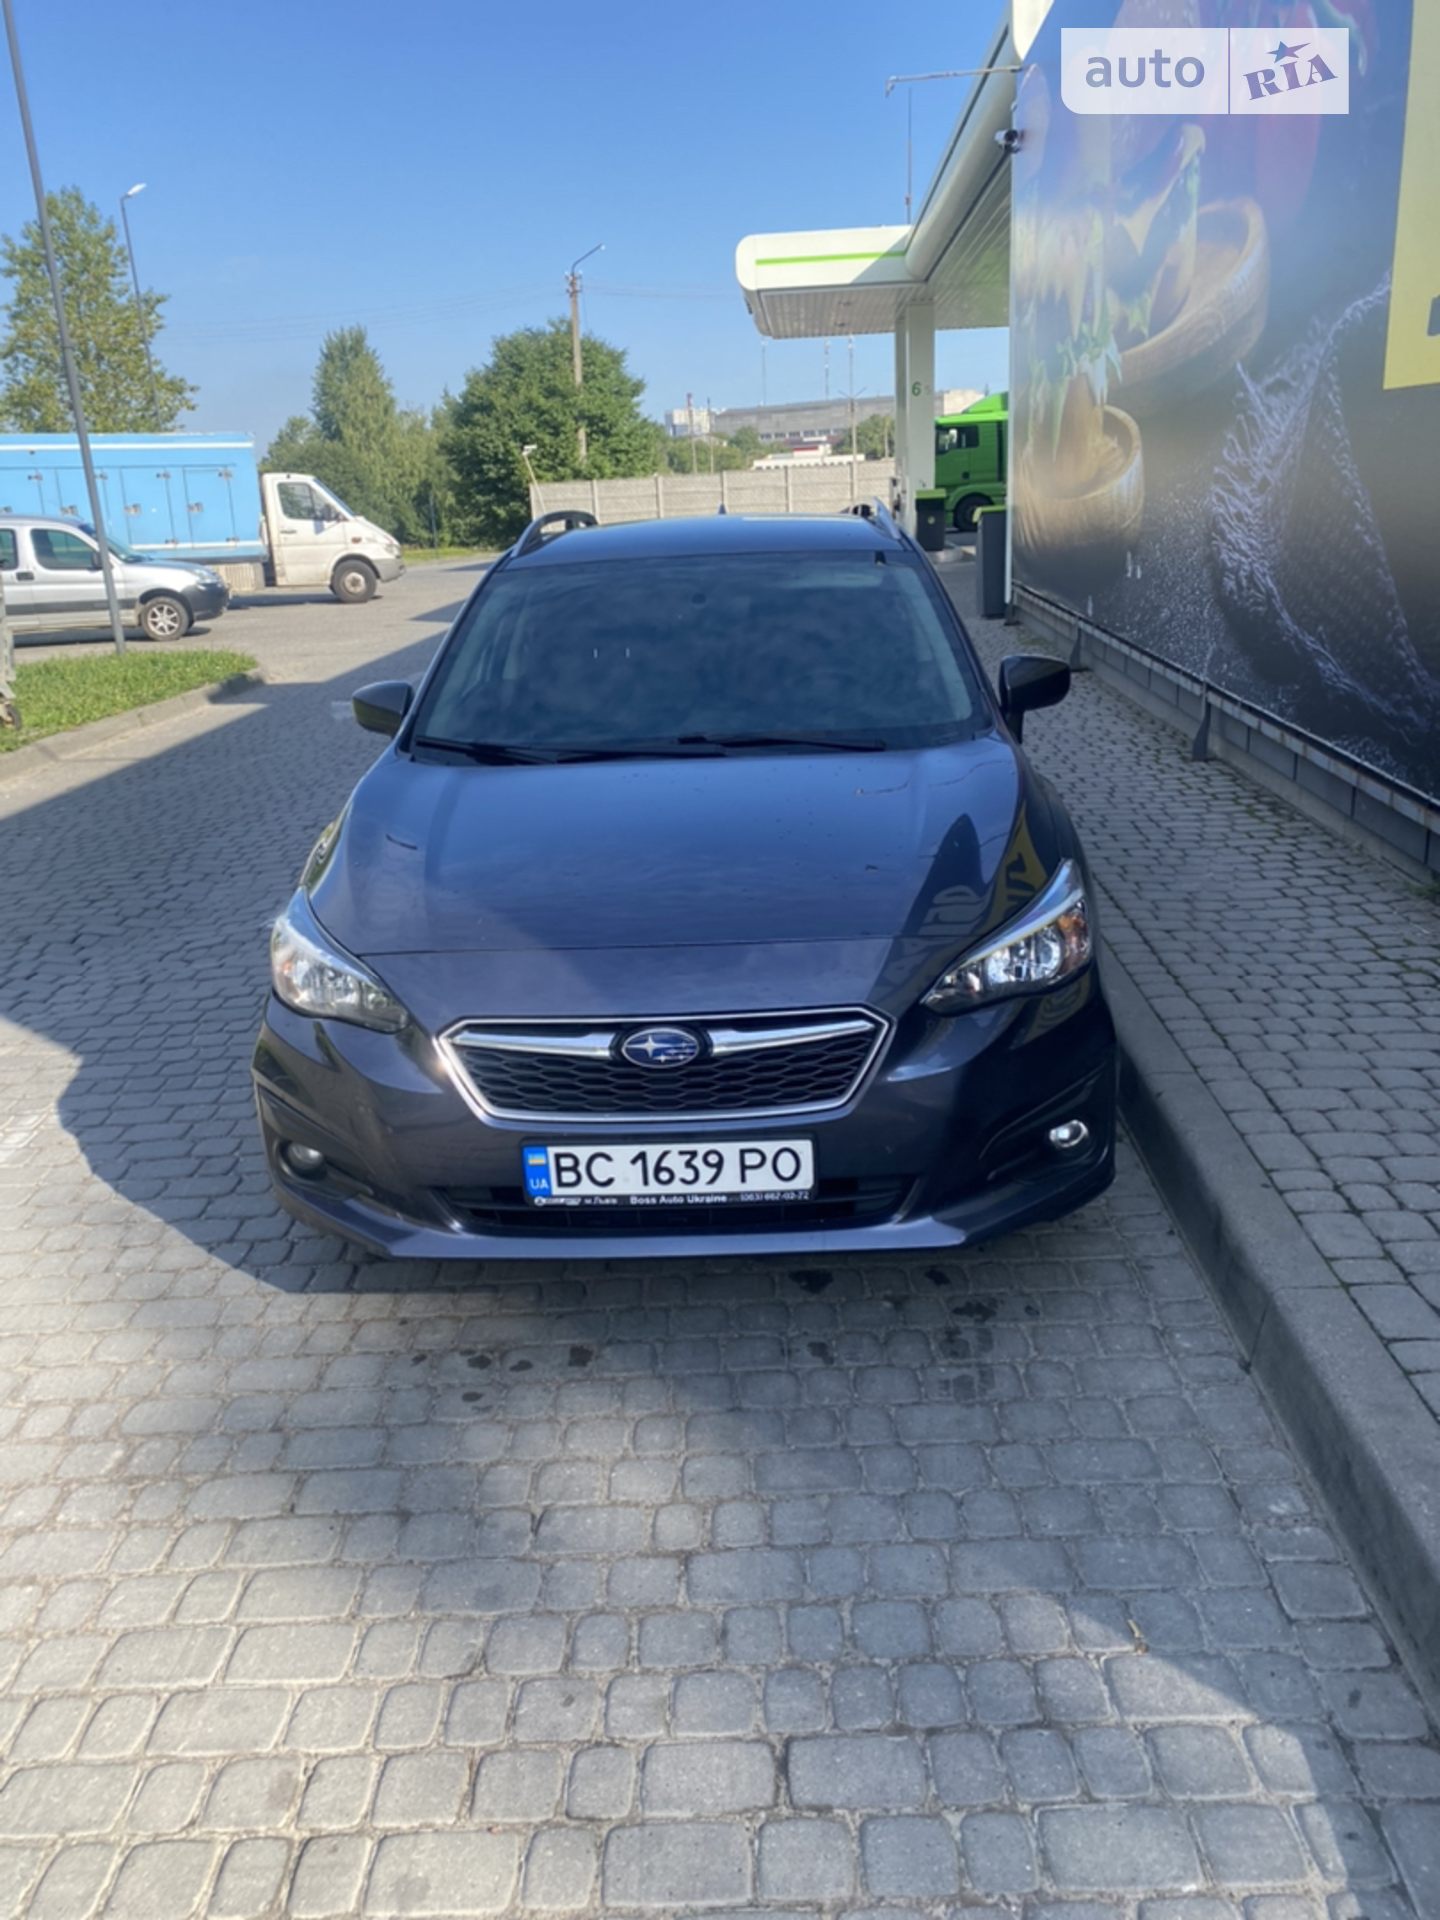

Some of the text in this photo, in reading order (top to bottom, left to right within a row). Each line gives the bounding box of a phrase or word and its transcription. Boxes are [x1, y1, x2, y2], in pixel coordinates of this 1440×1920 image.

[911, 381, 921, 397] 6
[554, 1147, 802, 1188] BC 1639 PO
[530, 1178, 549, 1190] UA
[630, 1193, 727, 1205] Boss Auto Ukraine
